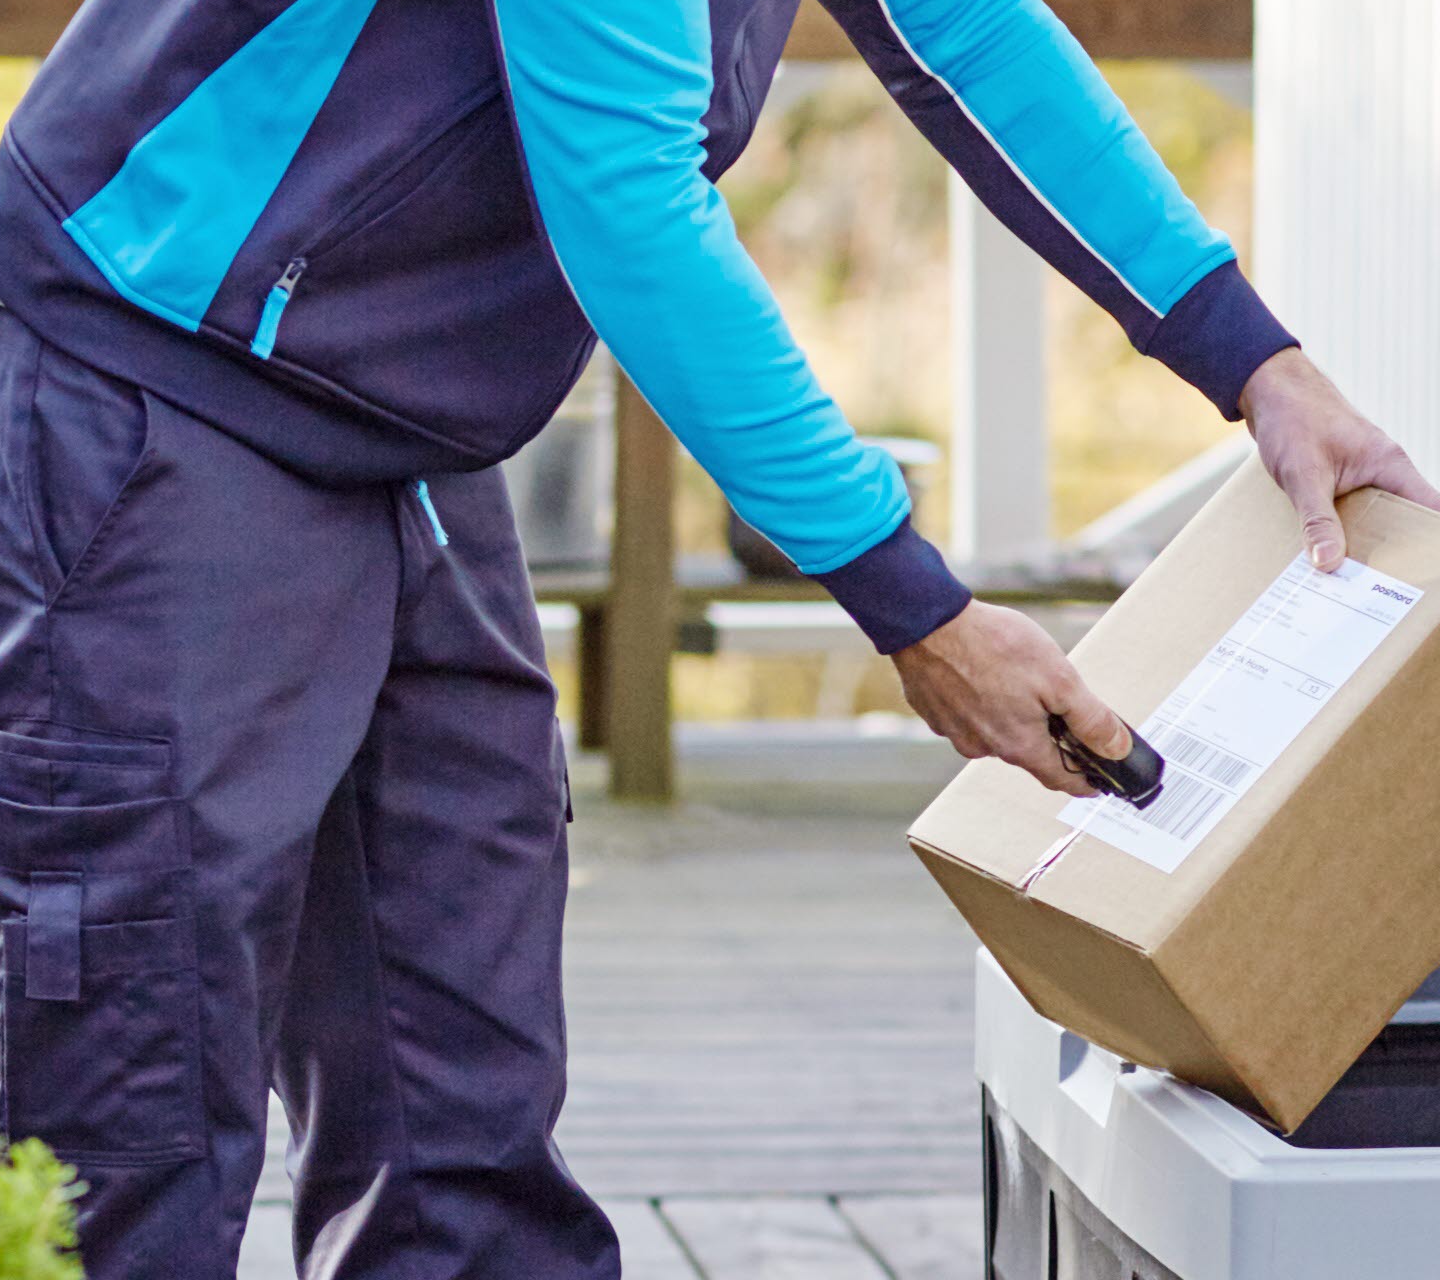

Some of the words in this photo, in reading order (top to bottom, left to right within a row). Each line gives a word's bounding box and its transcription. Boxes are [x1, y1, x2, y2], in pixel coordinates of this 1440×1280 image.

[1371, 584, 1414, 605] postnord
[1216, 646, 1245, 663] MyPck
[1246, 658, 1269, 674] Home
